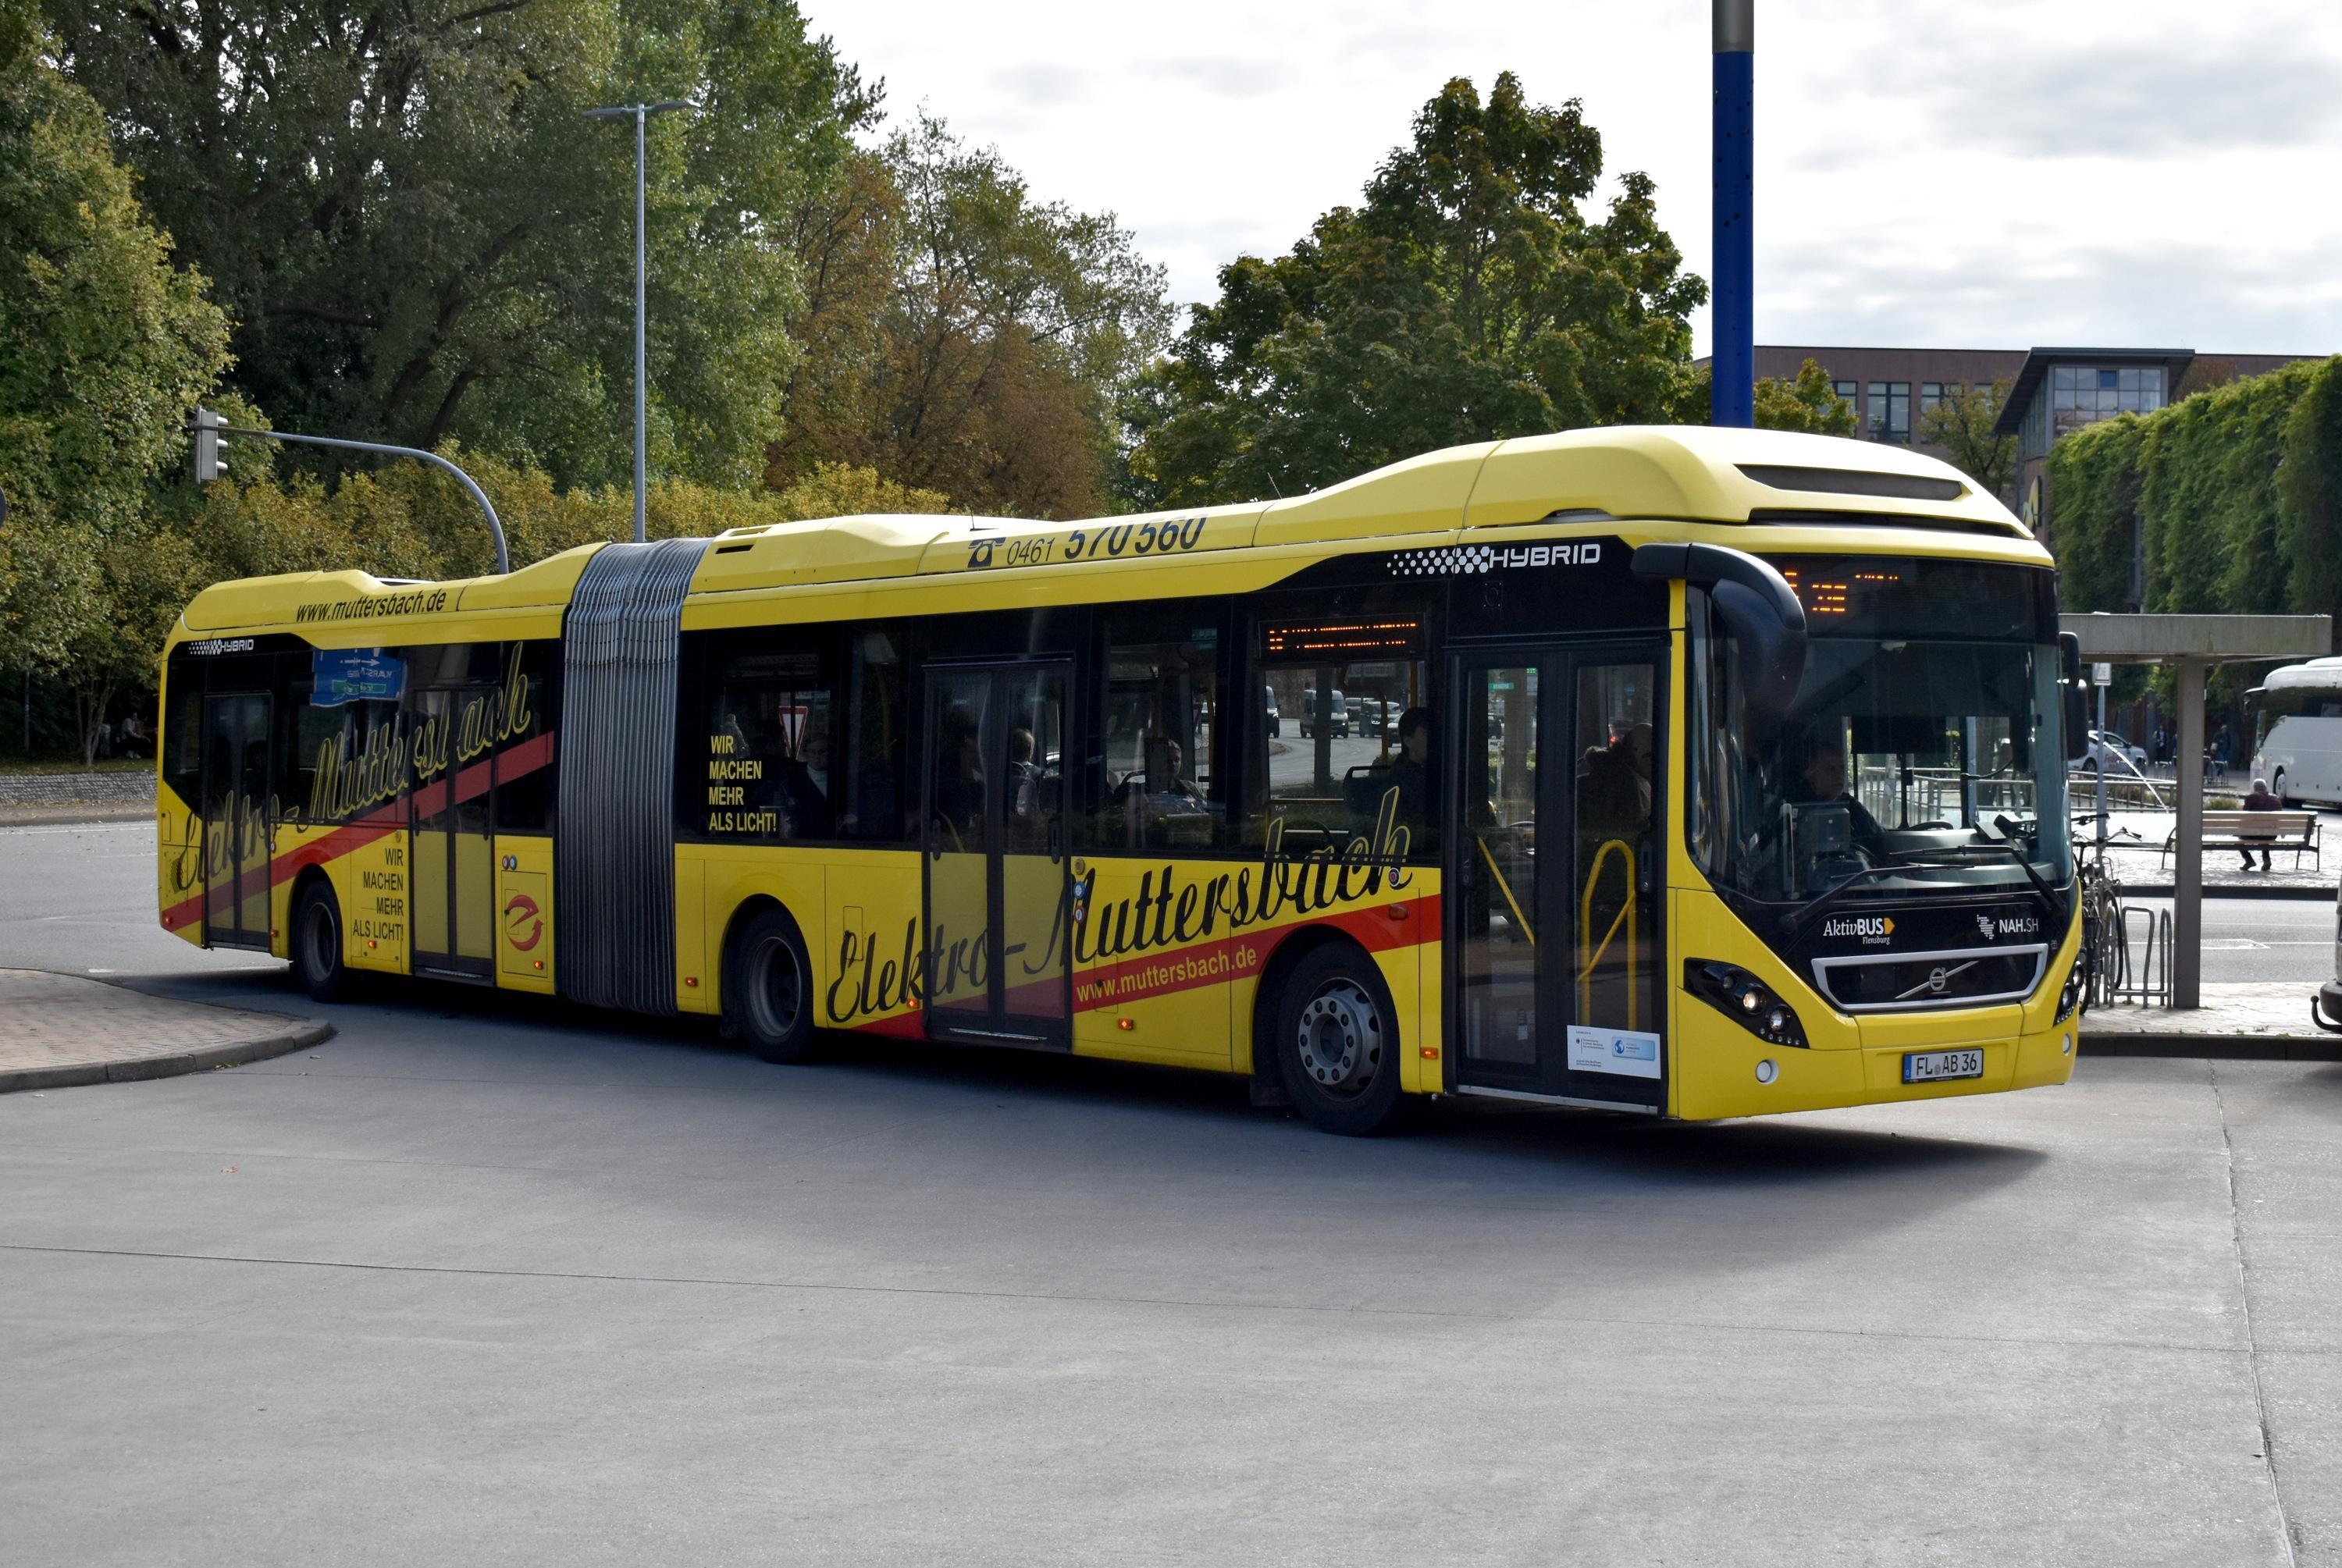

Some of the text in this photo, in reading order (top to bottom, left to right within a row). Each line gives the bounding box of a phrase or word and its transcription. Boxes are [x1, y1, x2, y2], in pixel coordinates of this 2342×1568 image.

[1007, 513, 1208, 565] 0461 570 560
[1489, 543, 1601, 569] HYBRID
[297, 588, 447, 622] www.muttersbach.de
[220, 639, 254, 652] HYBRID
[710, 735, 734, 754] WIR
[709, 760, 762, 780] MACHEN
[708, 786, 744, 805] MEHR
[709, 812, 777, 832] ALS LICHT!
[385, 848, 404, 866] WIR
[363, 871, 404, 891] MACHEN
[376, 897, 404, 916] MEHR
[353, 919, 404, 942] ALS LICHT!
[1823, 918, 1884, 937] AktivBUS
[1999, 918, 2039, 933] NAH.SH
[1862, 936, 1890, 946] Flensburg
[1077, 944, 1257, 1003] www.muttersbach.de
[1917, 1057, 1933, 1076] FL
[1942, 1055, 1958, 1074] AB
[1962, 1053, 1977, 1072] 36
